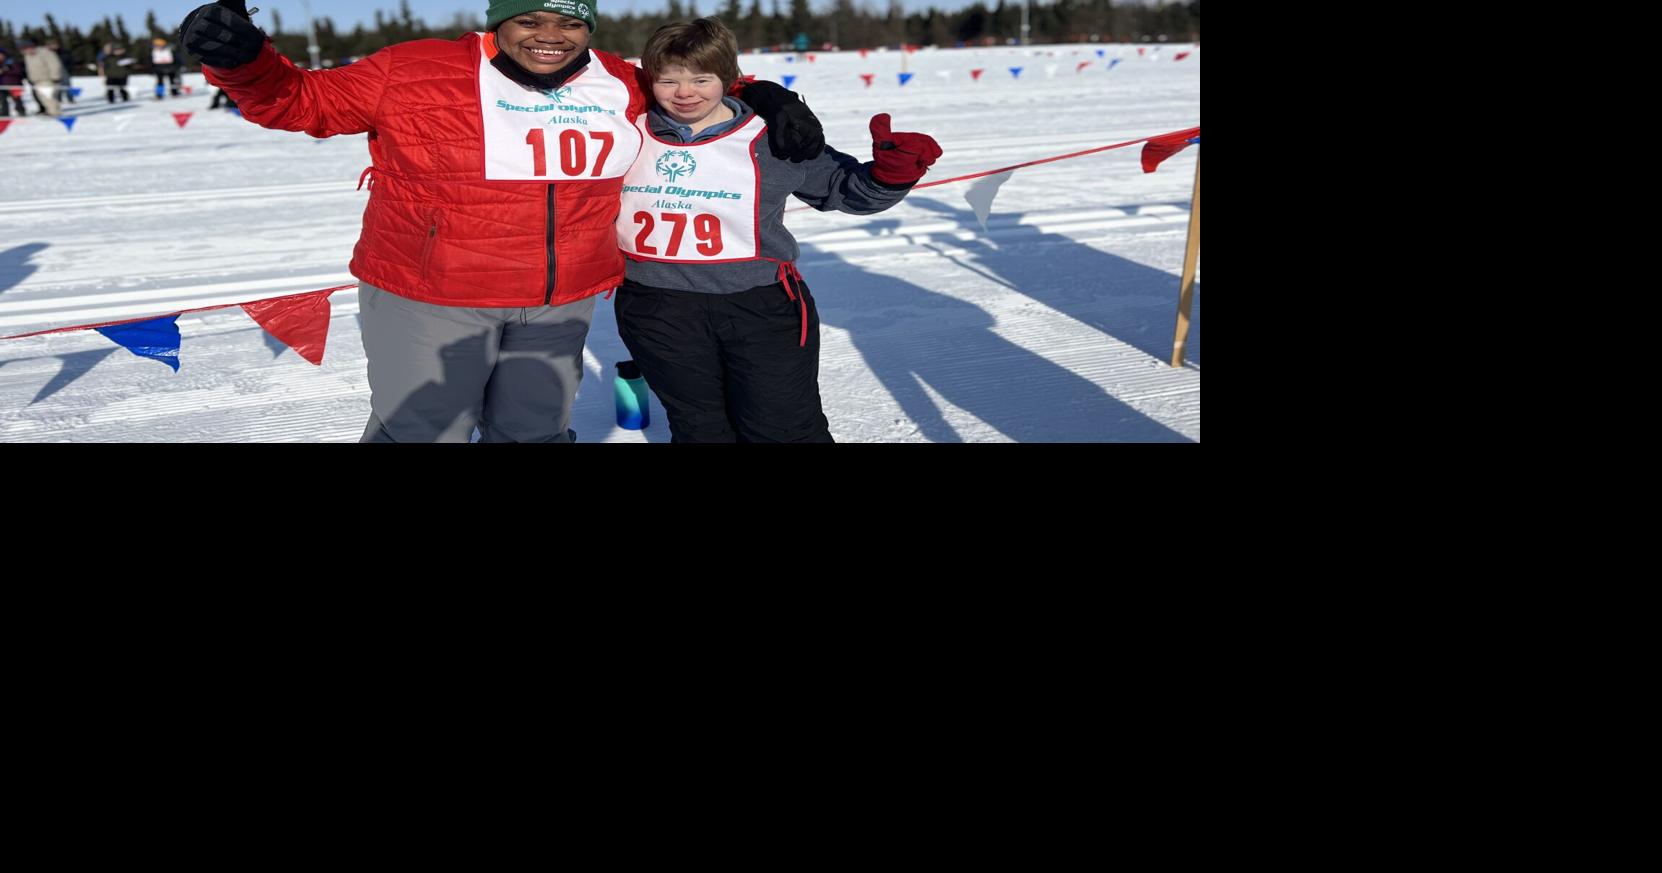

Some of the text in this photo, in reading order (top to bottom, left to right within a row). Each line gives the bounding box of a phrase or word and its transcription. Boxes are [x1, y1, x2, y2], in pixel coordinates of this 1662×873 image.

[496, 99, 555, 112] Special
[547, 115, 588, 125] Alaska
[525, 128, 615, 177] 107
[620, 184, 743, 200] pecial Olympics
[651, 199, 692, 210] Alaska
[633, 210, 724, 257] 279
